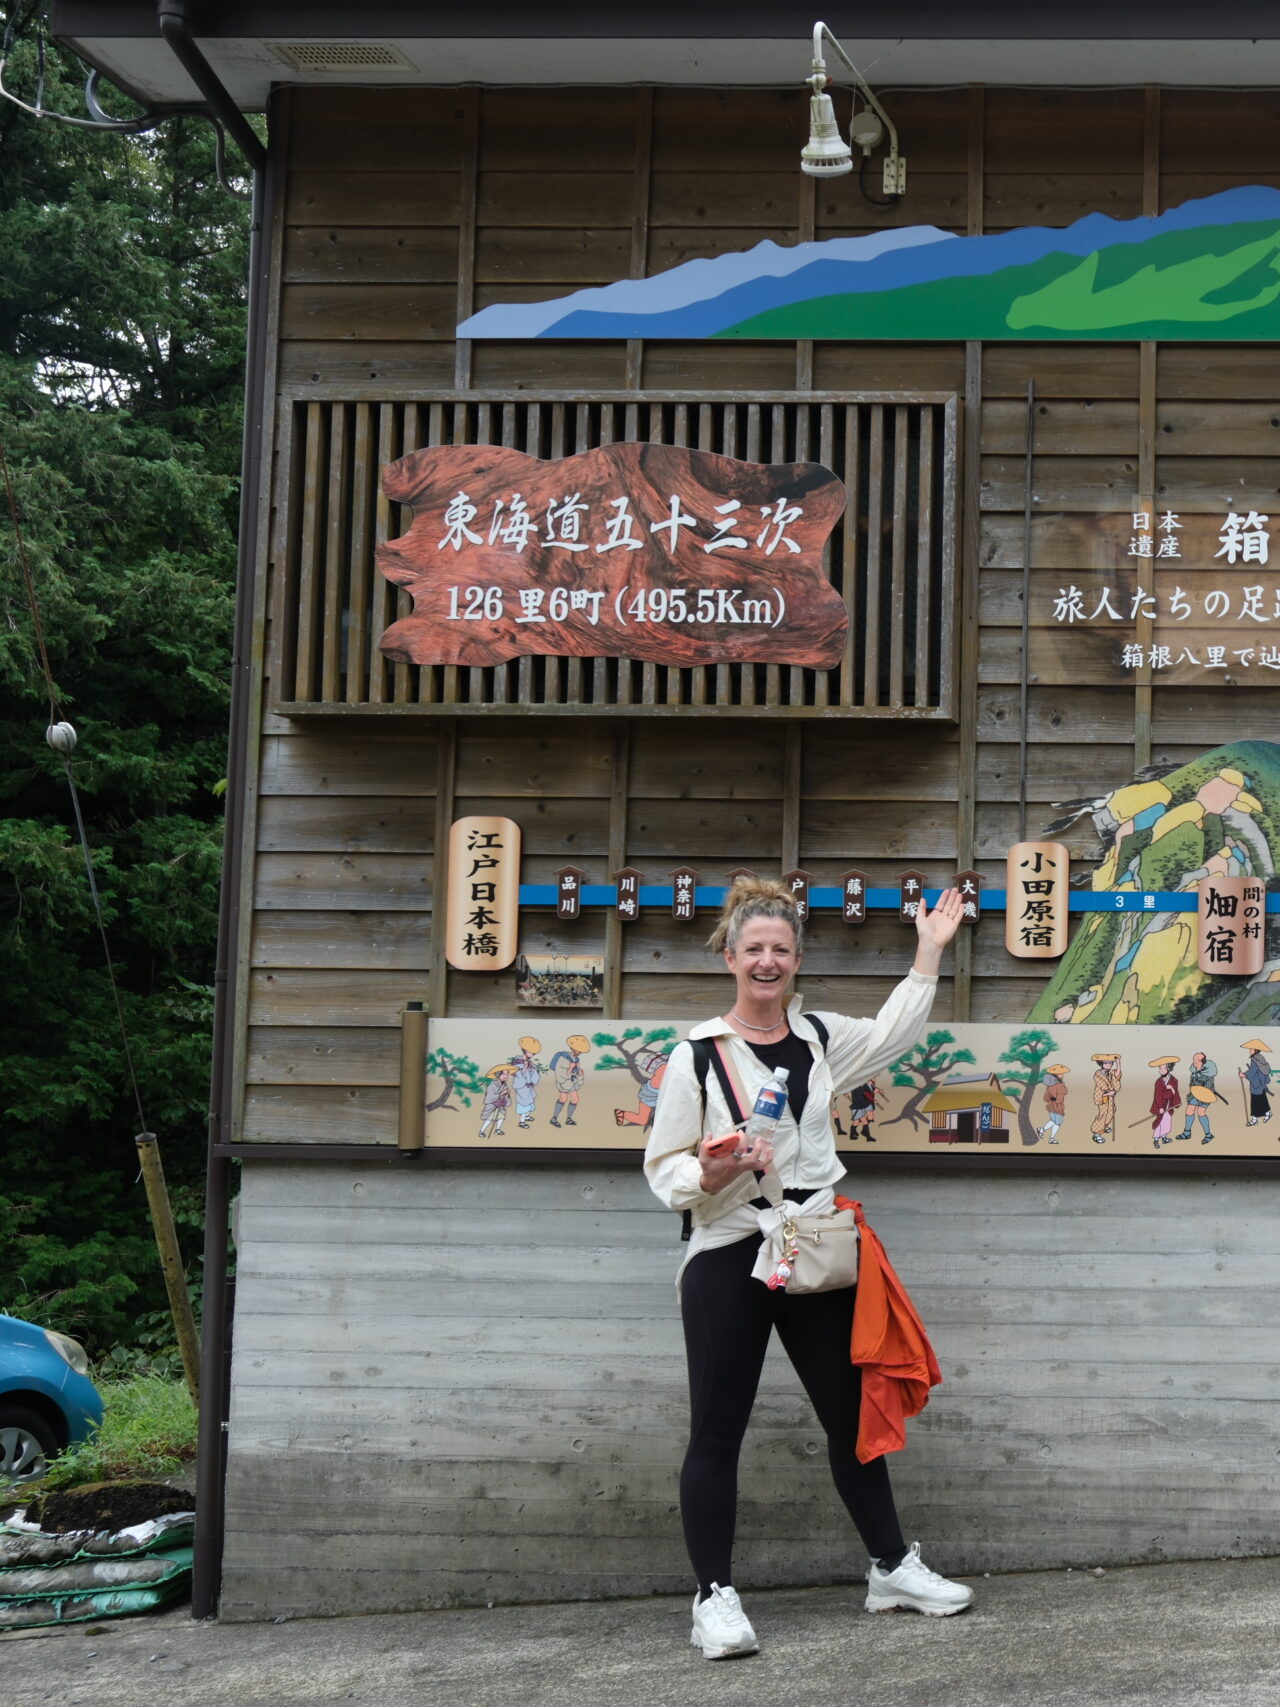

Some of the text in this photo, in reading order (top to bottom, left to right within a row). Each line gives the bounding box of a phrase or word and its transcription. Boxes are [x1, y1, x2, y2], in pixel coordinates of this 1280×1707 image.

[437, 490, 804, 556] 東海道五十三次
[1131, 510, 1184, 532] 日本
[1126, 535, 1183, 559] 遺産
[462, 828, 504, 958] 江戸日本橋
[560, 875, 576, 914] 品川
[619, 875, 636, 916] 川崎
[674, 874, 693, 918] 神奈川
[846, 878, 863, 917] 藤沢
[1018, 851, 1057, 948] 小田原宿
[1241, 886, 1262, 940] 間の村
[1204, 887, 1239, 964] 畑宿
[981, 1104, 992, 1129] だんご
